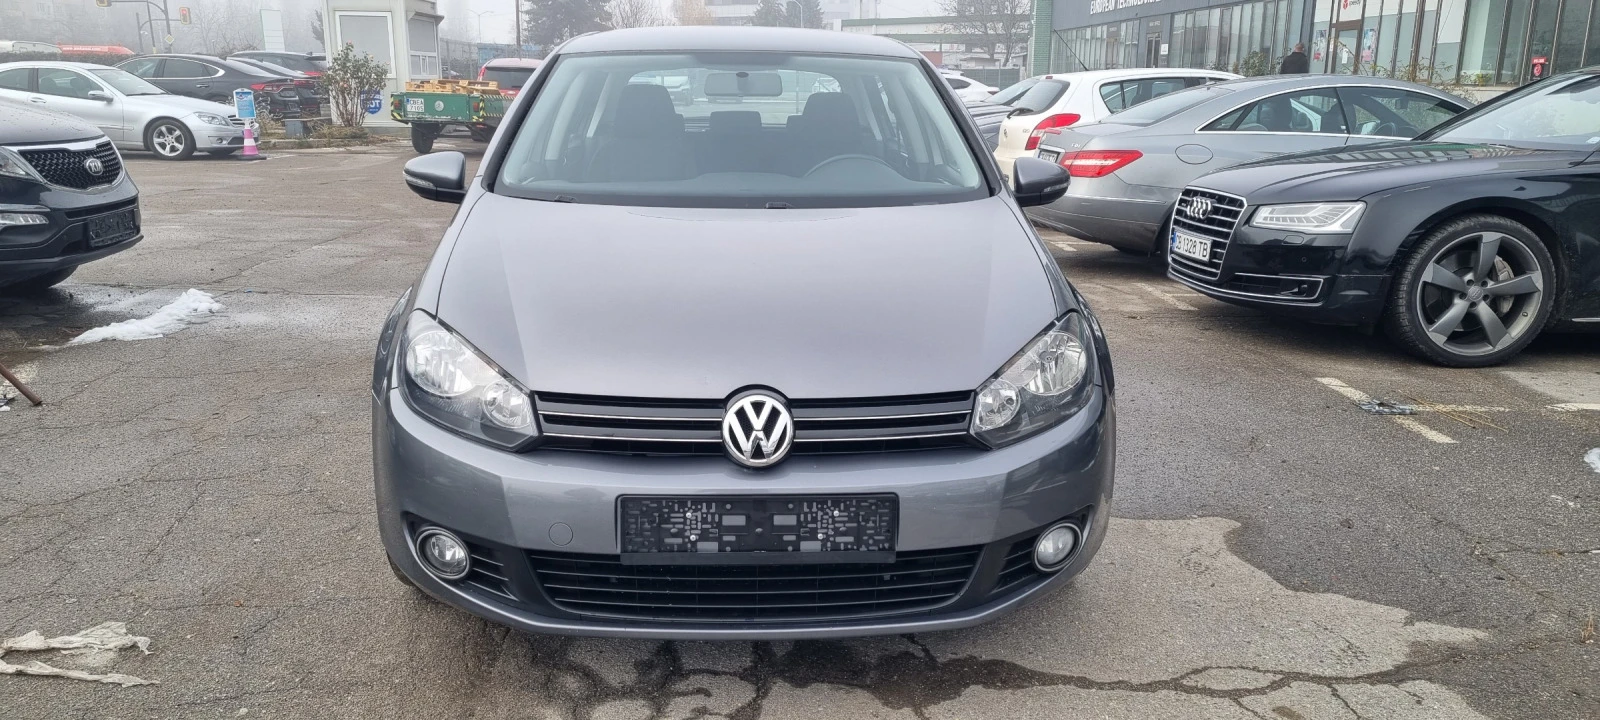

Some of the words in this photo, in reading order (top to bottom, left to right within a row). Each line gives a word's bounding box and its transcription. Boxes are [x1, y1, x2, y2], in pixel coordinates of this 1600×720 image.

[1183, 237, 1197, 255] 1328
[1199, 241, 1209, 258] TB
[723, 394, 793, 466] VW
